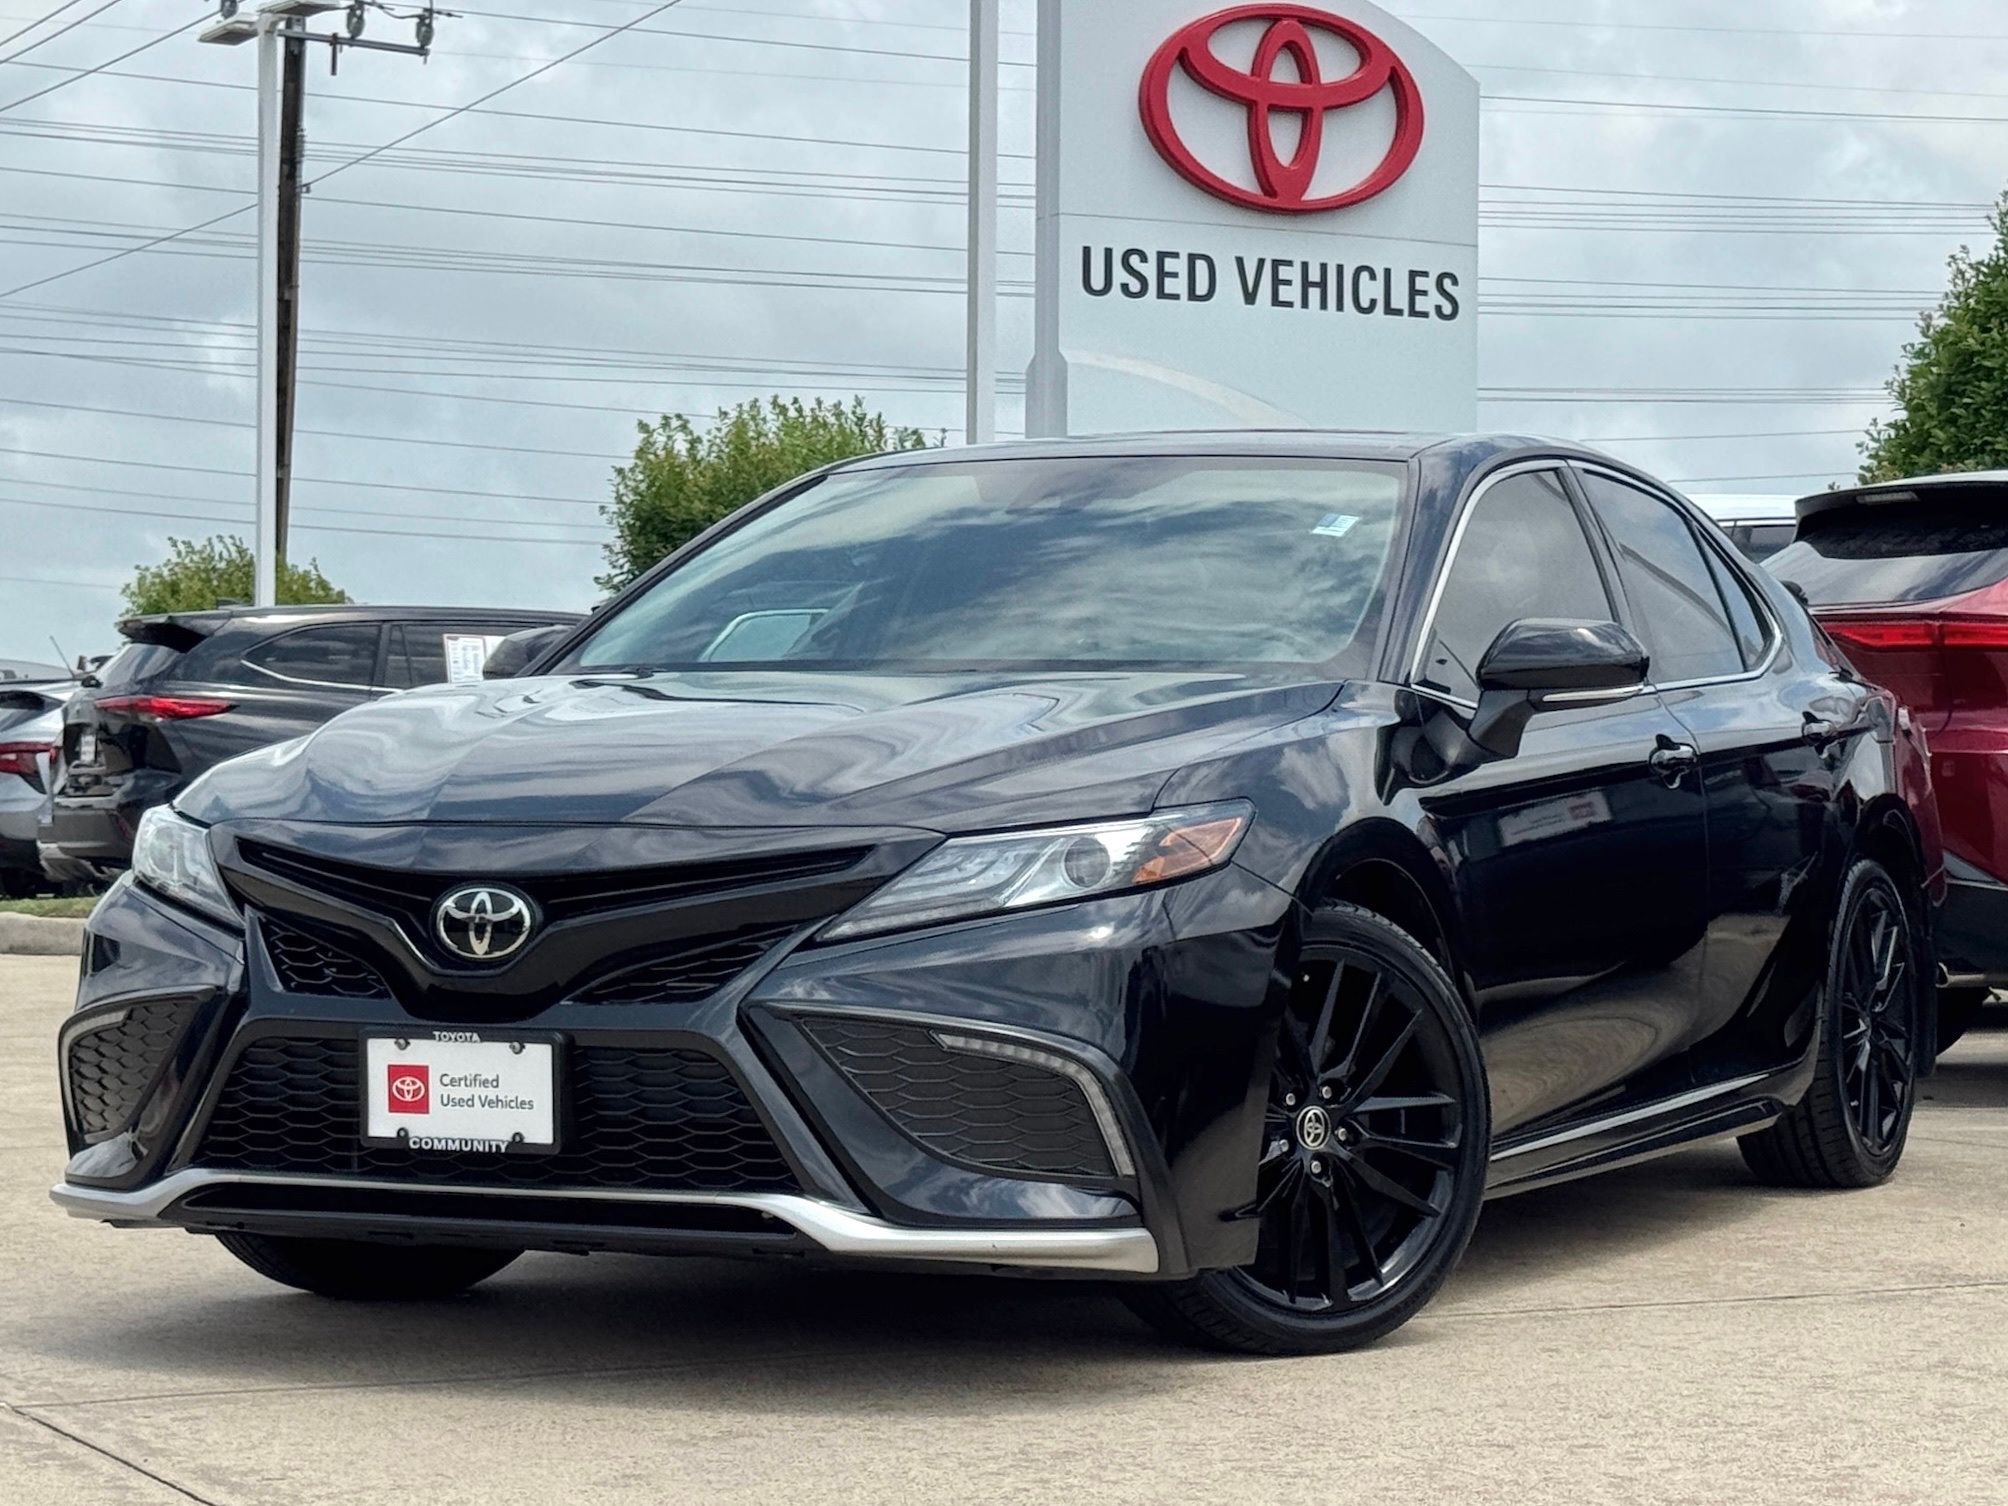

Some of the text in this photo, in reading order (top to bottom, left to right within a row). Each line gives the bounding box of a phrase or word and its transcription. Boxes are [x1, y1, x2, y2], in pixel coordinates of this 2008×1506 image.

[1081, 245, 1460, 322] USED VEHICLES
[432, 1031, 481, 1043] TOYOTA
[439, 1074, 499, 1088] Certified
[440, 1094, 535, 1110] Used Vehicles
[408, 1136, 509, 1153] COMMUNITY
